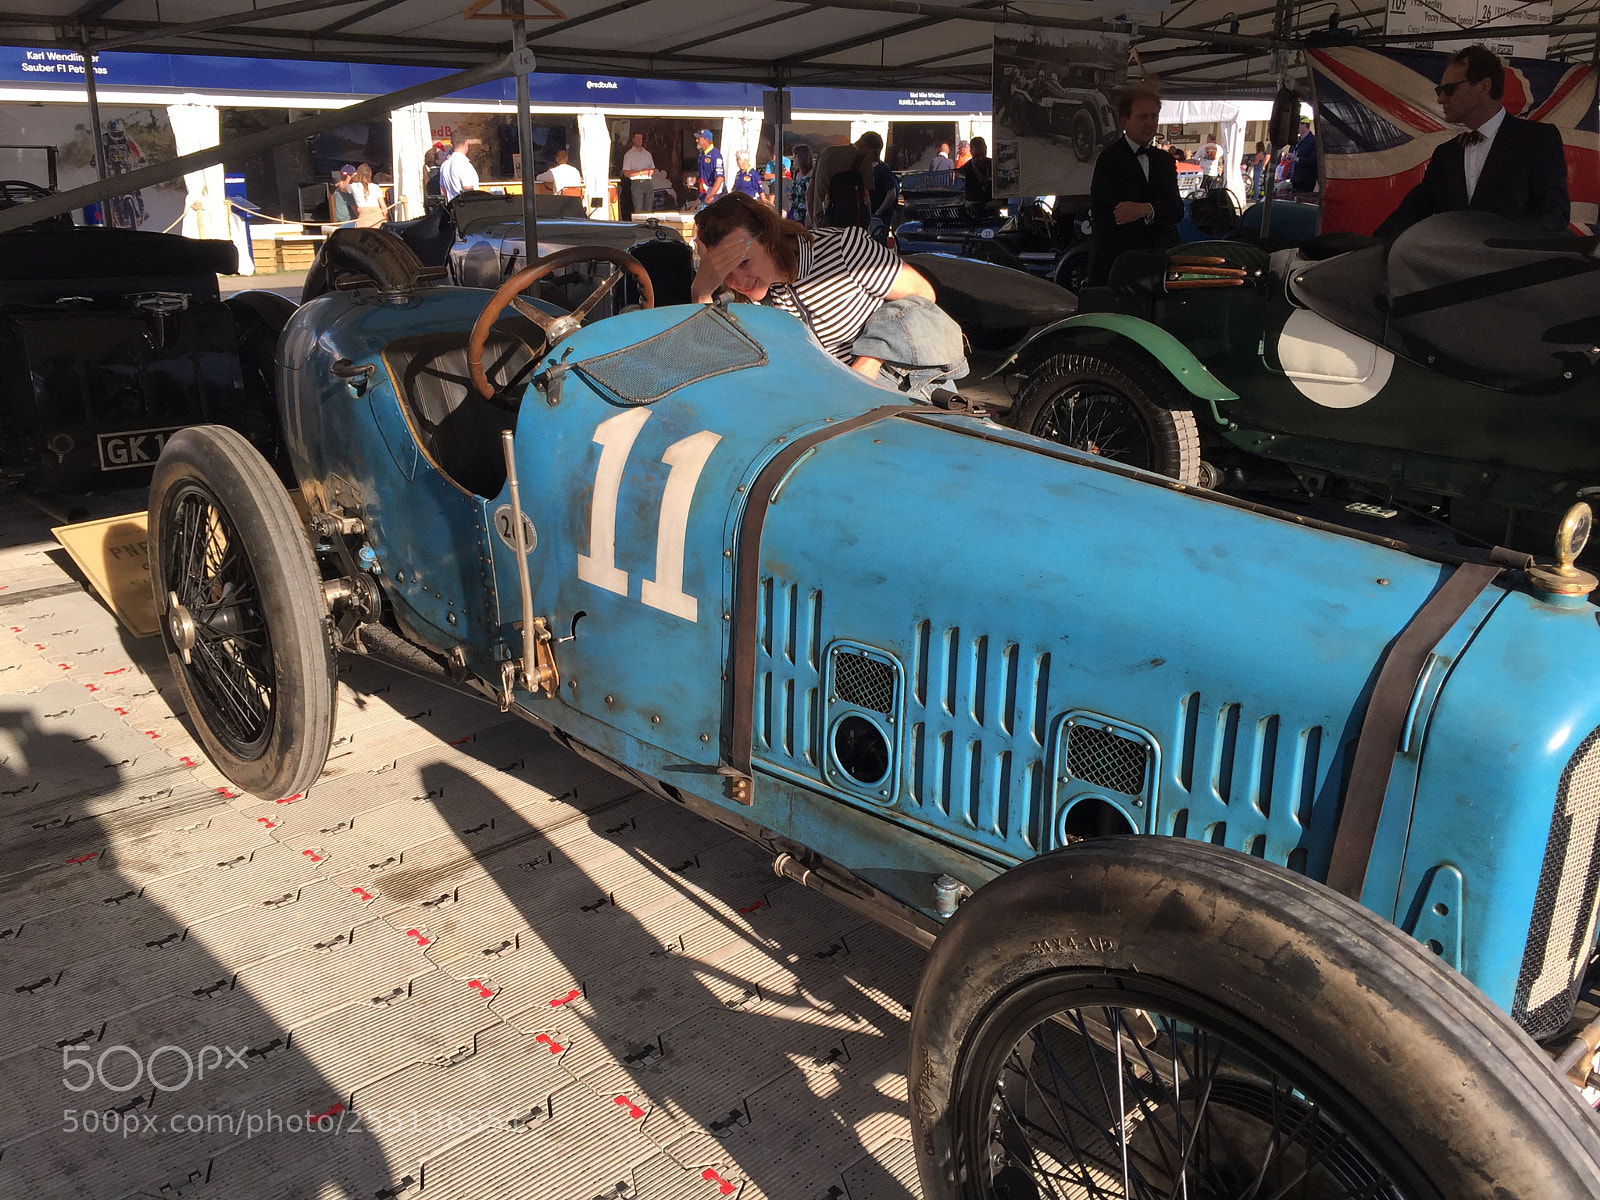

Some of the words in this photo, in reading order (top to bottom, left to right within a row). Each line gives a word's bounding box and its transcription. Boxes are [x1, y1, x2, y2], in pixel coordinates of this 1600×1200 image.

[1482, 5, 1492, 20] 26
[26, 51, 45, 60] Karl
[46, 52, 100, 63] Wendliner
[21, 63, 56, 72] Sauber
[68, 65, 108, 75] Petnas
[108, 436, 150, 464] GK
[578, 406, 723, 623] 11
[501, 515, 529, 545] 21
